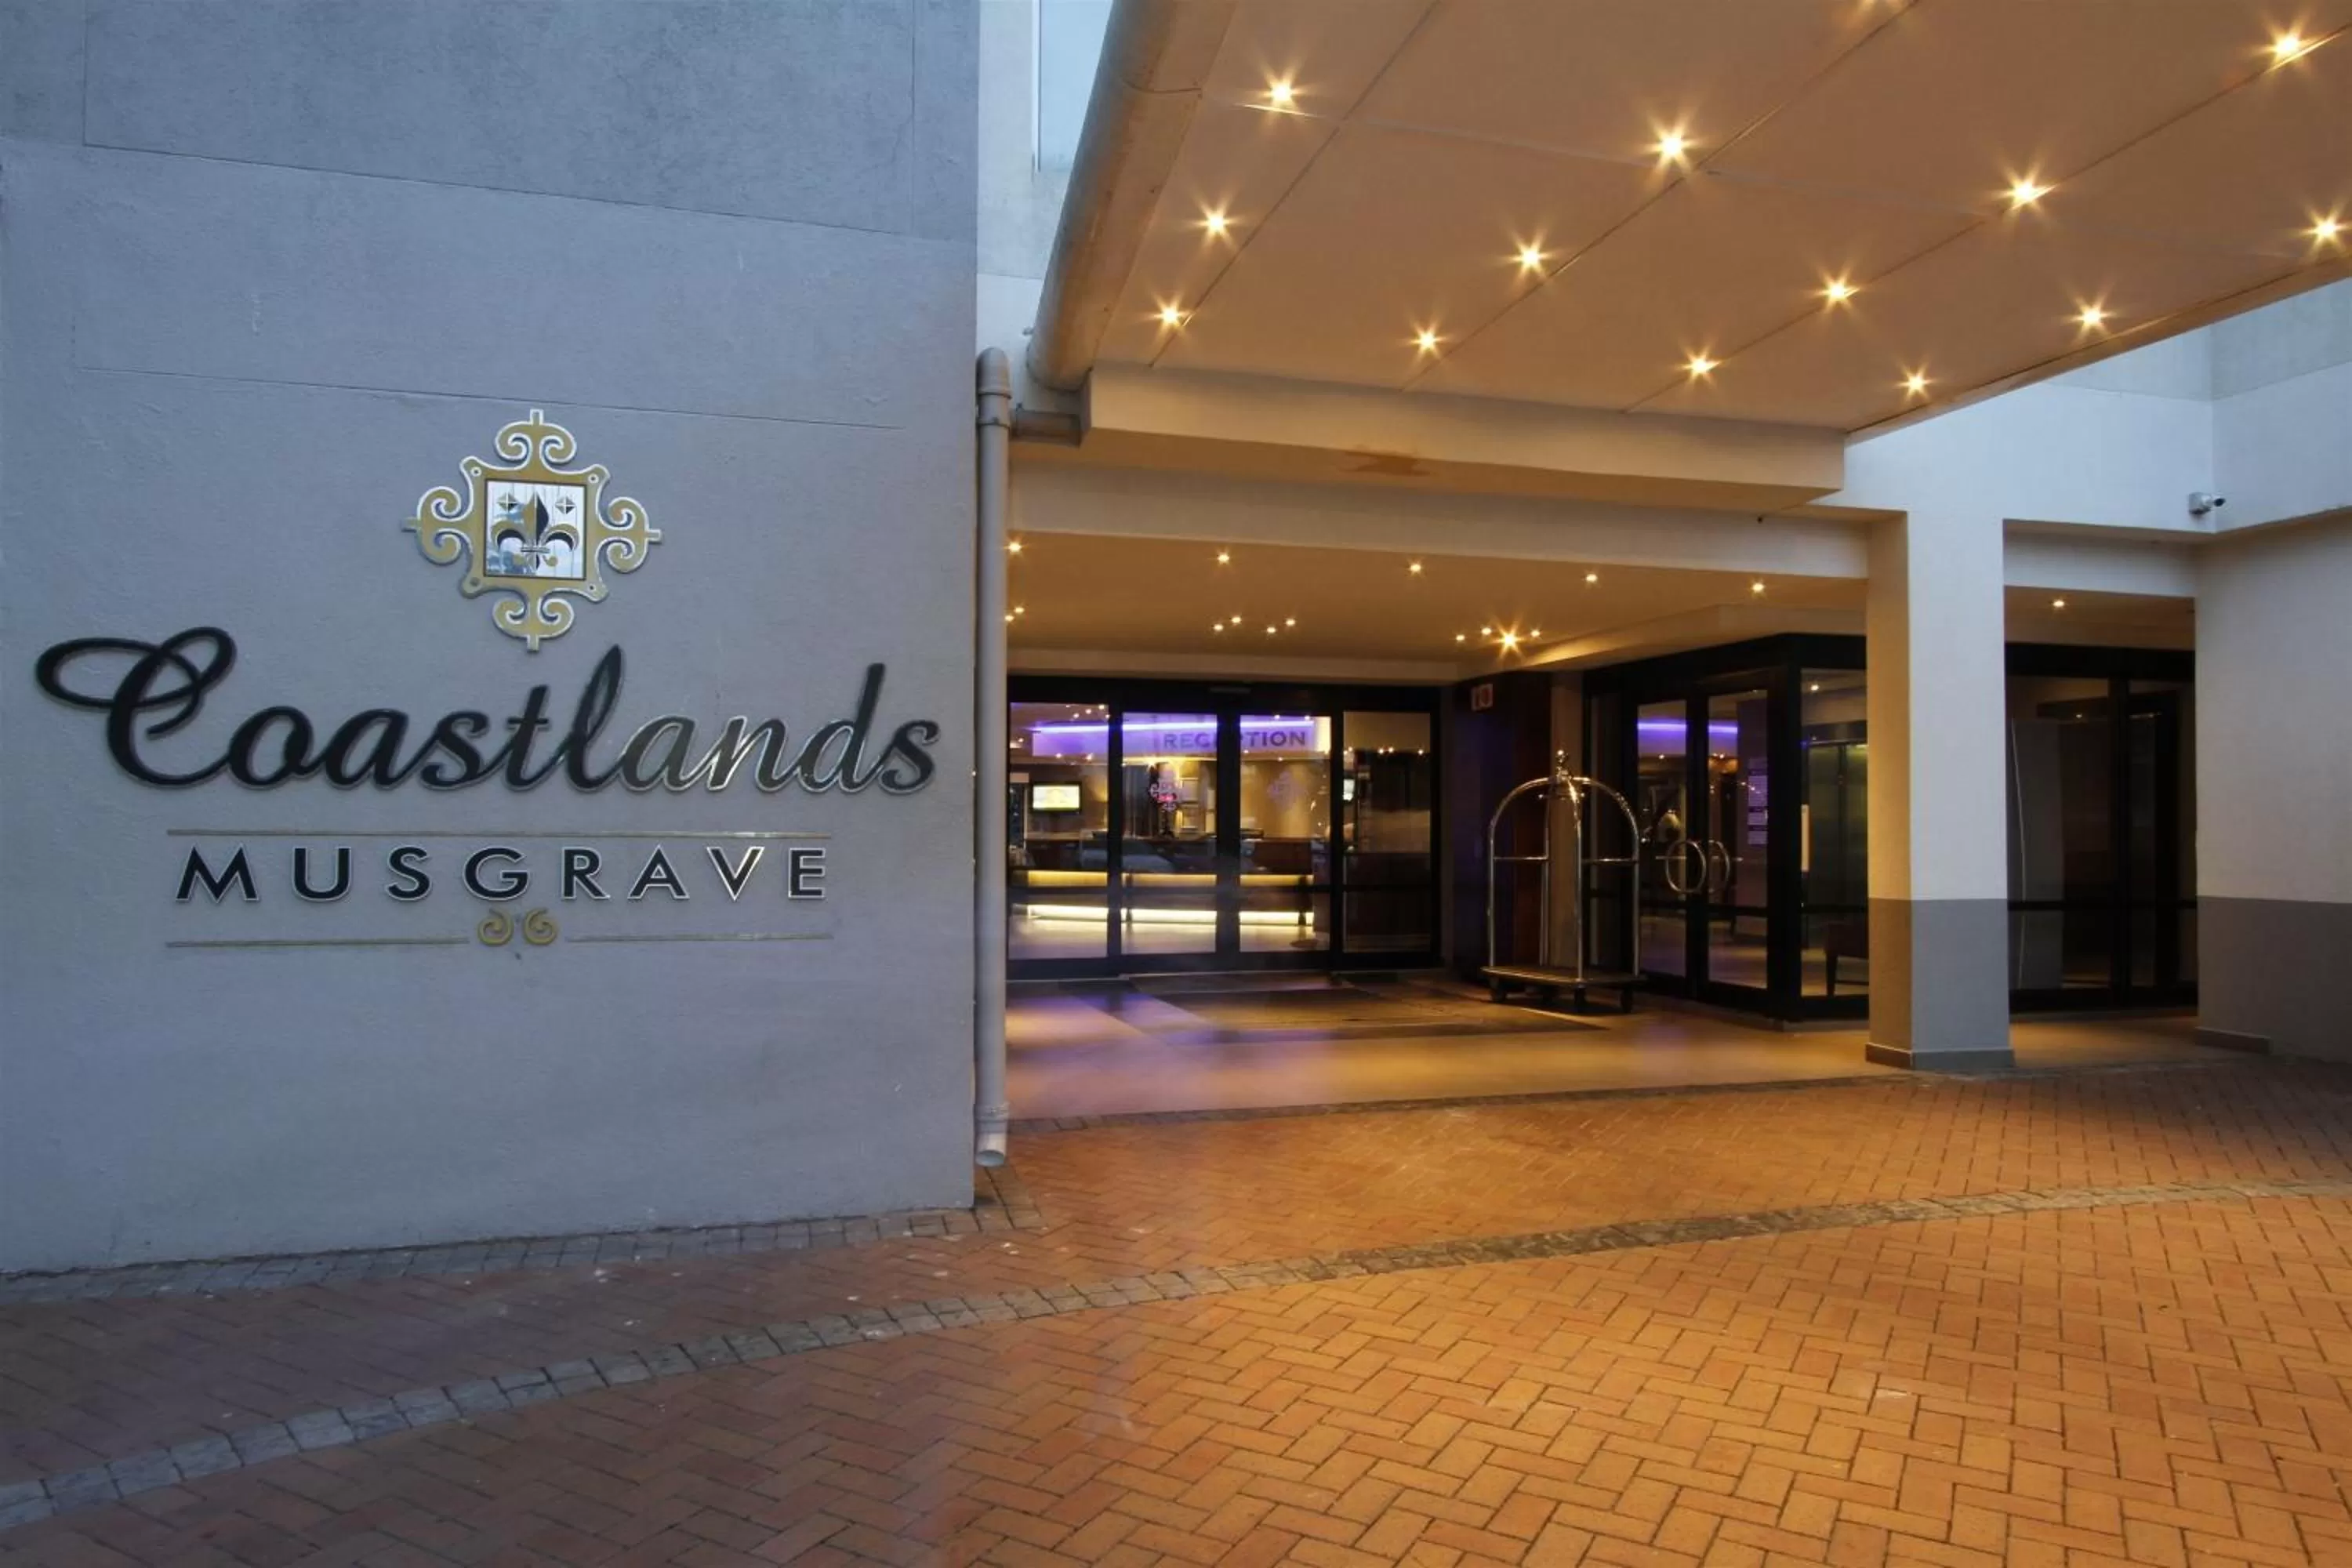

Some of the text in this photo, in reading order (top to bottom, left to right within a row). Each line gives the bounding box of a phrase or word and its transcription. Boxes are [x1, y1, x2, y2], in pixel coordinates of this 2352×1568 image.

[36, 627, 938, 793] Coastlands
[1163, 731, 1305, 748] RECTION
[176, 844, 826, 902] MUSGRAVE
